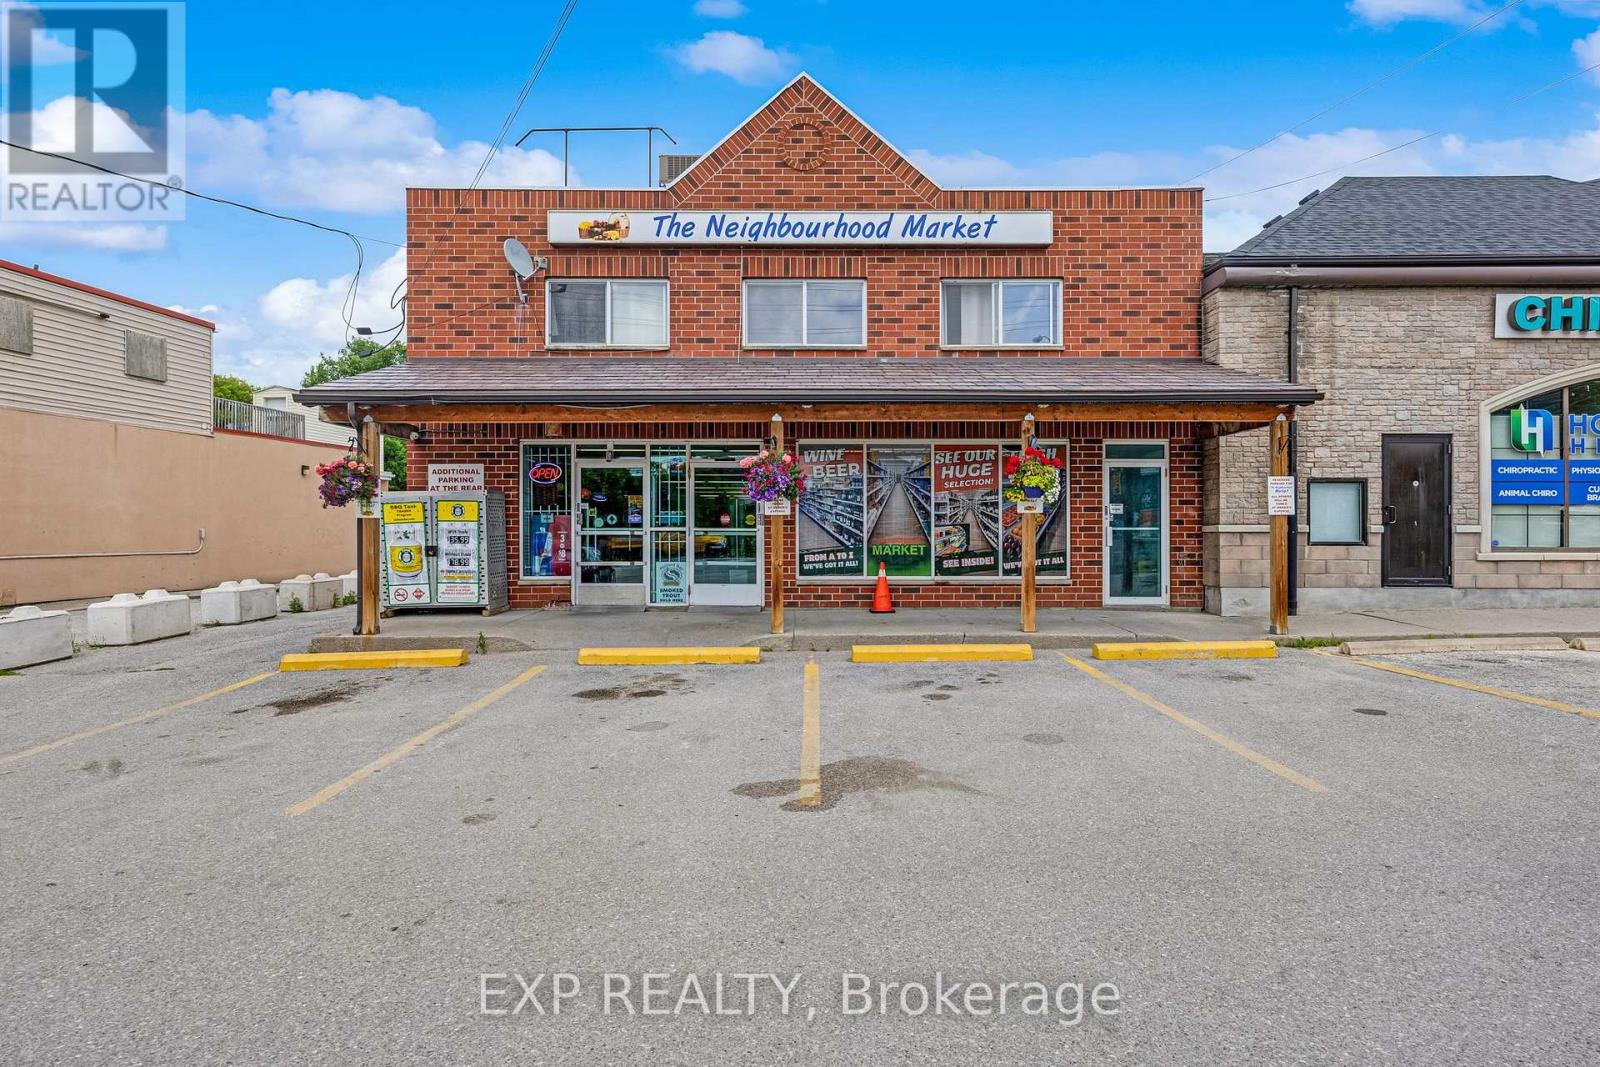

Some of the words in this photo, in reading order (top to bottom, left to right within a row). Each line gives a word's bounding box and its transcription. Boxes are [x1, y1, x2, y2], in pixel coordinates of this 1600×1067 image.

[653, 212, 695, 238] The
[705, 212, 894, 242] Neighbourhood
[901, 214, 997, 239] Market
[1510, 296, 1600, 331] CHI
[804, 448, 845, 463] WINE
[935, 451, 961, 464] SEE
[964, 449, 996, 462] OUR
[532, 467, 559, 479] OPEN
[812, 463, 860, 479] BEER
[941, 463, 993, 479] HUGE
[943, 478, 994, 489] SELECTION!
[1498, 489, 1530, 497] ANIMAL
[1532, 489, 1558, 497] CHIRO
[872, 544, 927, 556] MARKET
[804, 553, 827, 562] FROM
[829, 552, 835, 561] A
[836, 552, 847, 560] TO
[943, 559, 960, 568] SEE
[961, 556, 995, 567] INSIDE!
[1003, 561, 1022, 570] WE'V
[1051, 556, 1065, 565] ALL
[803, 562, 823, 570] WE'VE
[824, 561, 837, 569] GOT
